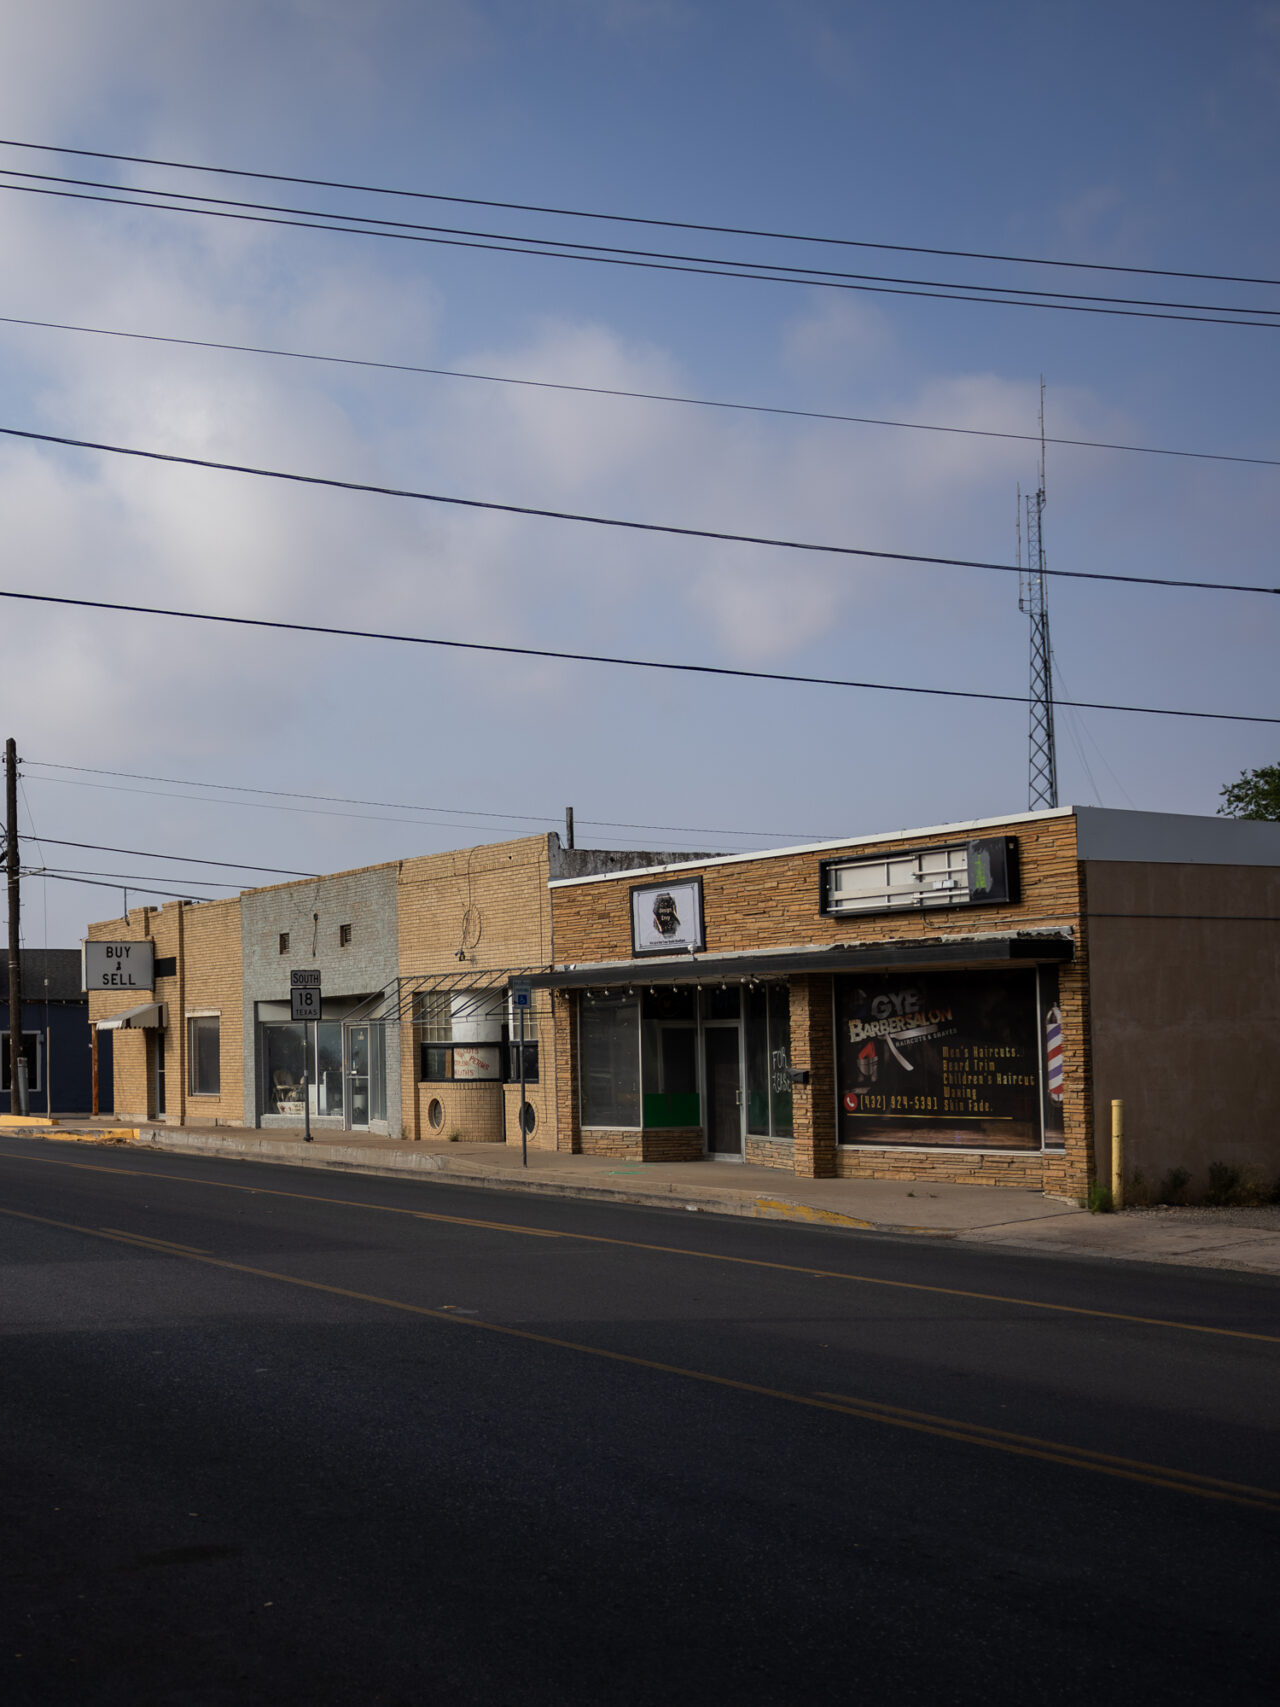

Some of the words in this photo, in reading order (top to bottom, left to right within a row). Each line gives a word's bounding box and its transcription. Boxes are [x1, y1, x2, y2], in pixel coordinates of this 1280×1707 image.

[106, 946, 131, 958] BUY
[102, 973, 136, 986] SELL
[293, 973, 319, 984] SOUTH
[299, 992, 313, 1006] 18
[871, 991, 920, 1019] GYE
[895, 1034, 927, 1048] HAIRCUTS
[772, 1046, 788, 1070] FOR
[942, 1059, 970, 1071] Beard
[973, 1059, 996, 1071] Trim
[943, 1071, 993, 1085] Children's
[996, 1072, 1036, 1086] Haircut
[943, 1086, 977, 1100] Waxing
[890, 1095, 938, 1110] 924-5391
[944, 1099, 965, 1112] Skin
